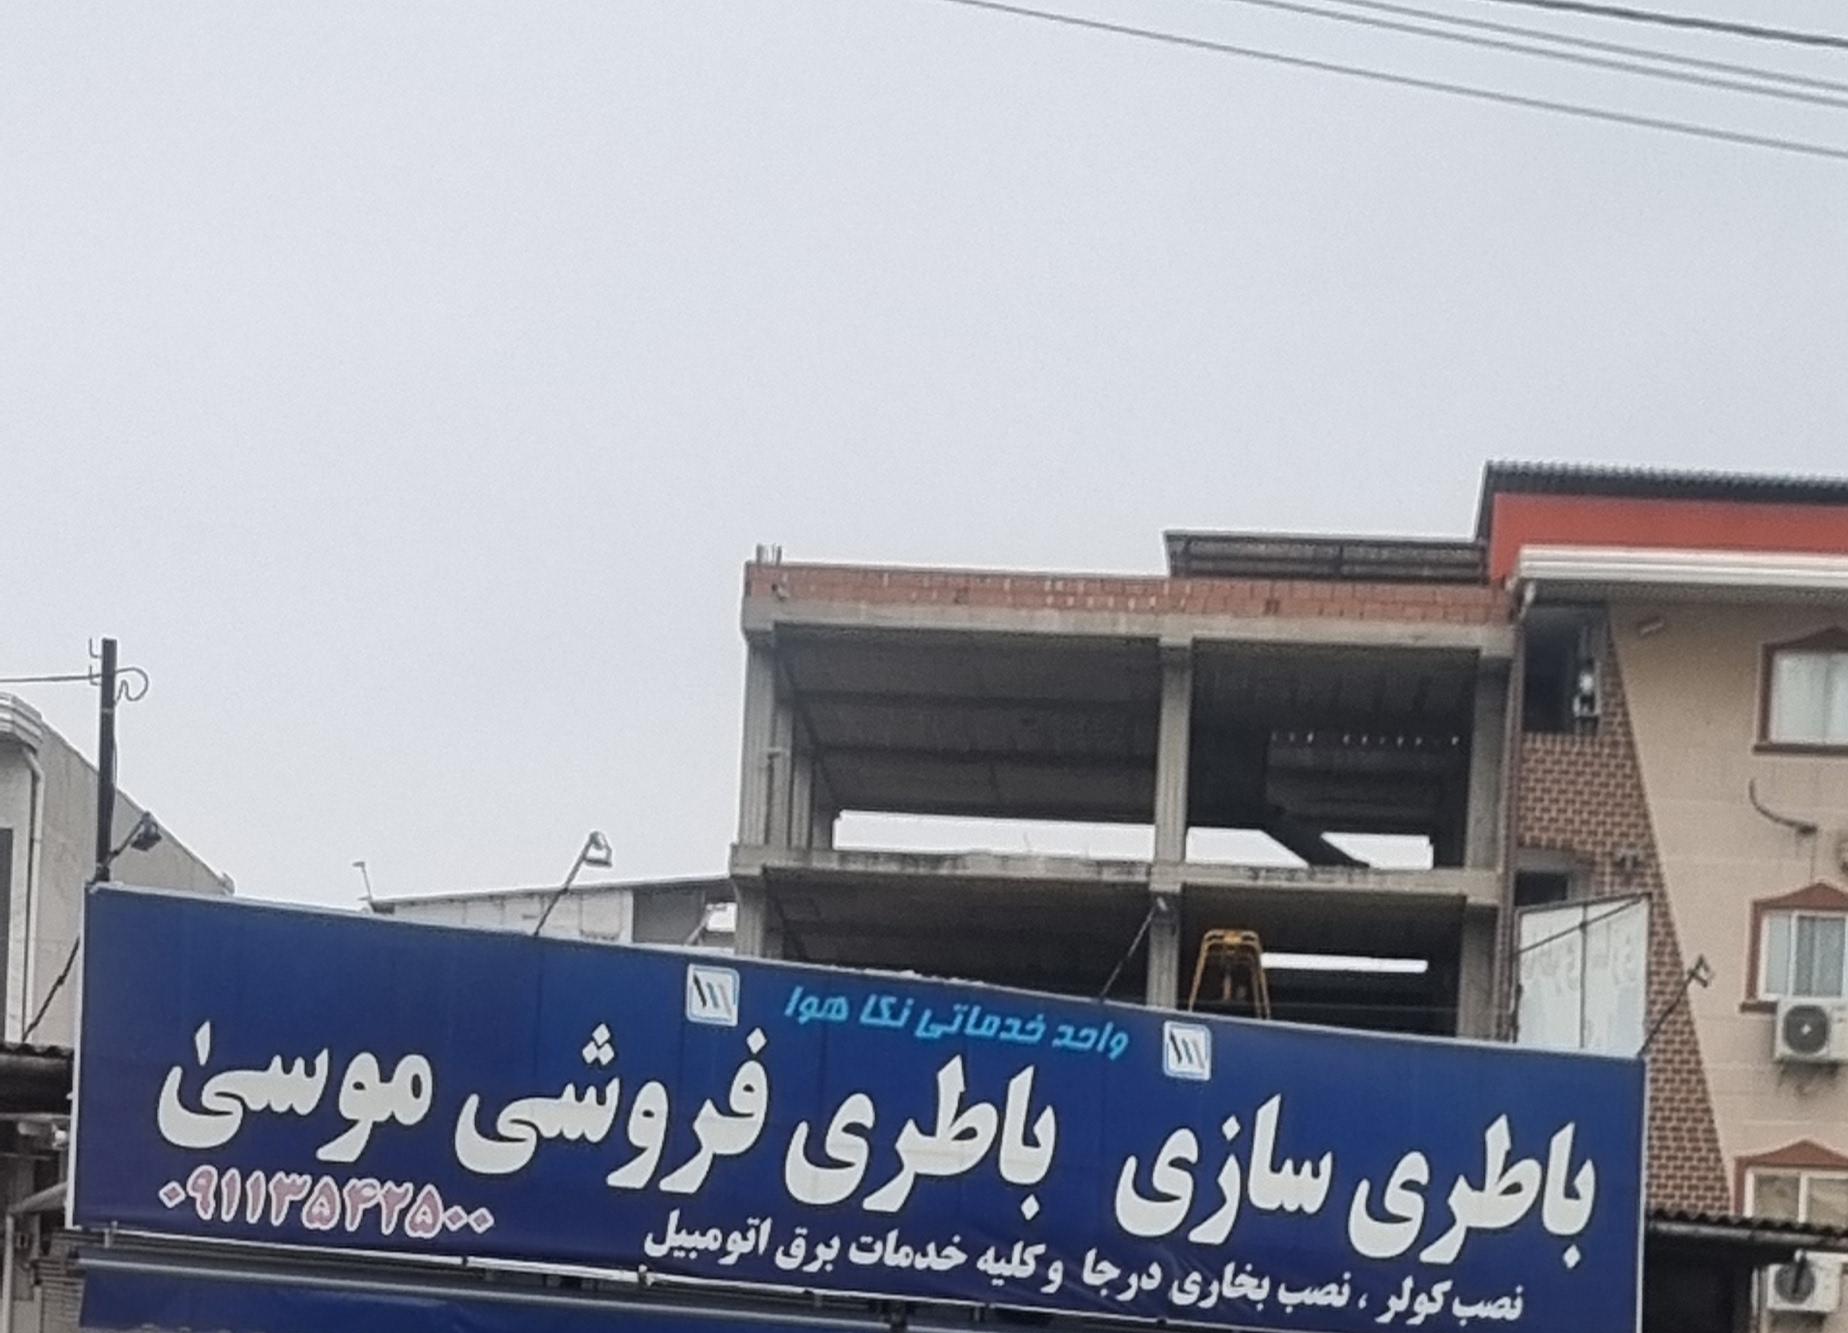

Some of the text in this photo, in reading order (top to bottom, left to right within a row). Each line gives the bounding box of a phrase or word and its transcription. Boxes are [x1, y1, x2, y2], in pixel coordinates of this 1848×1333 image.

[784, 986, 849, 1025] هوا
[914, 1003, 1046, 1043] خدماتی
[1052, 1022, 1129, 1060] واحد
[454, 1023, 769, 1194] فروشی
[785, 1055, 1057, 1220] باطری
[1115, 1094, 1332, 1245] سازی
[1348, 1114, 1596, 1269] باطری
[158, 1164, 496, 1240] ۰۹۱۱۳۵۴۲۵۰۰
[644, 1209, 773, 1266] اتومبیل
[775, 1227, 841, 1274] برق
[848, 1230, 968, 1272] خدمات
[1168, 1260, 1271, 1314] بخاری
[1277, 1270, 1351, 1314] نصب
[1374, 1274, 1453, 1326] کولر
[1452, 1284, 1524, 1327] نصب
